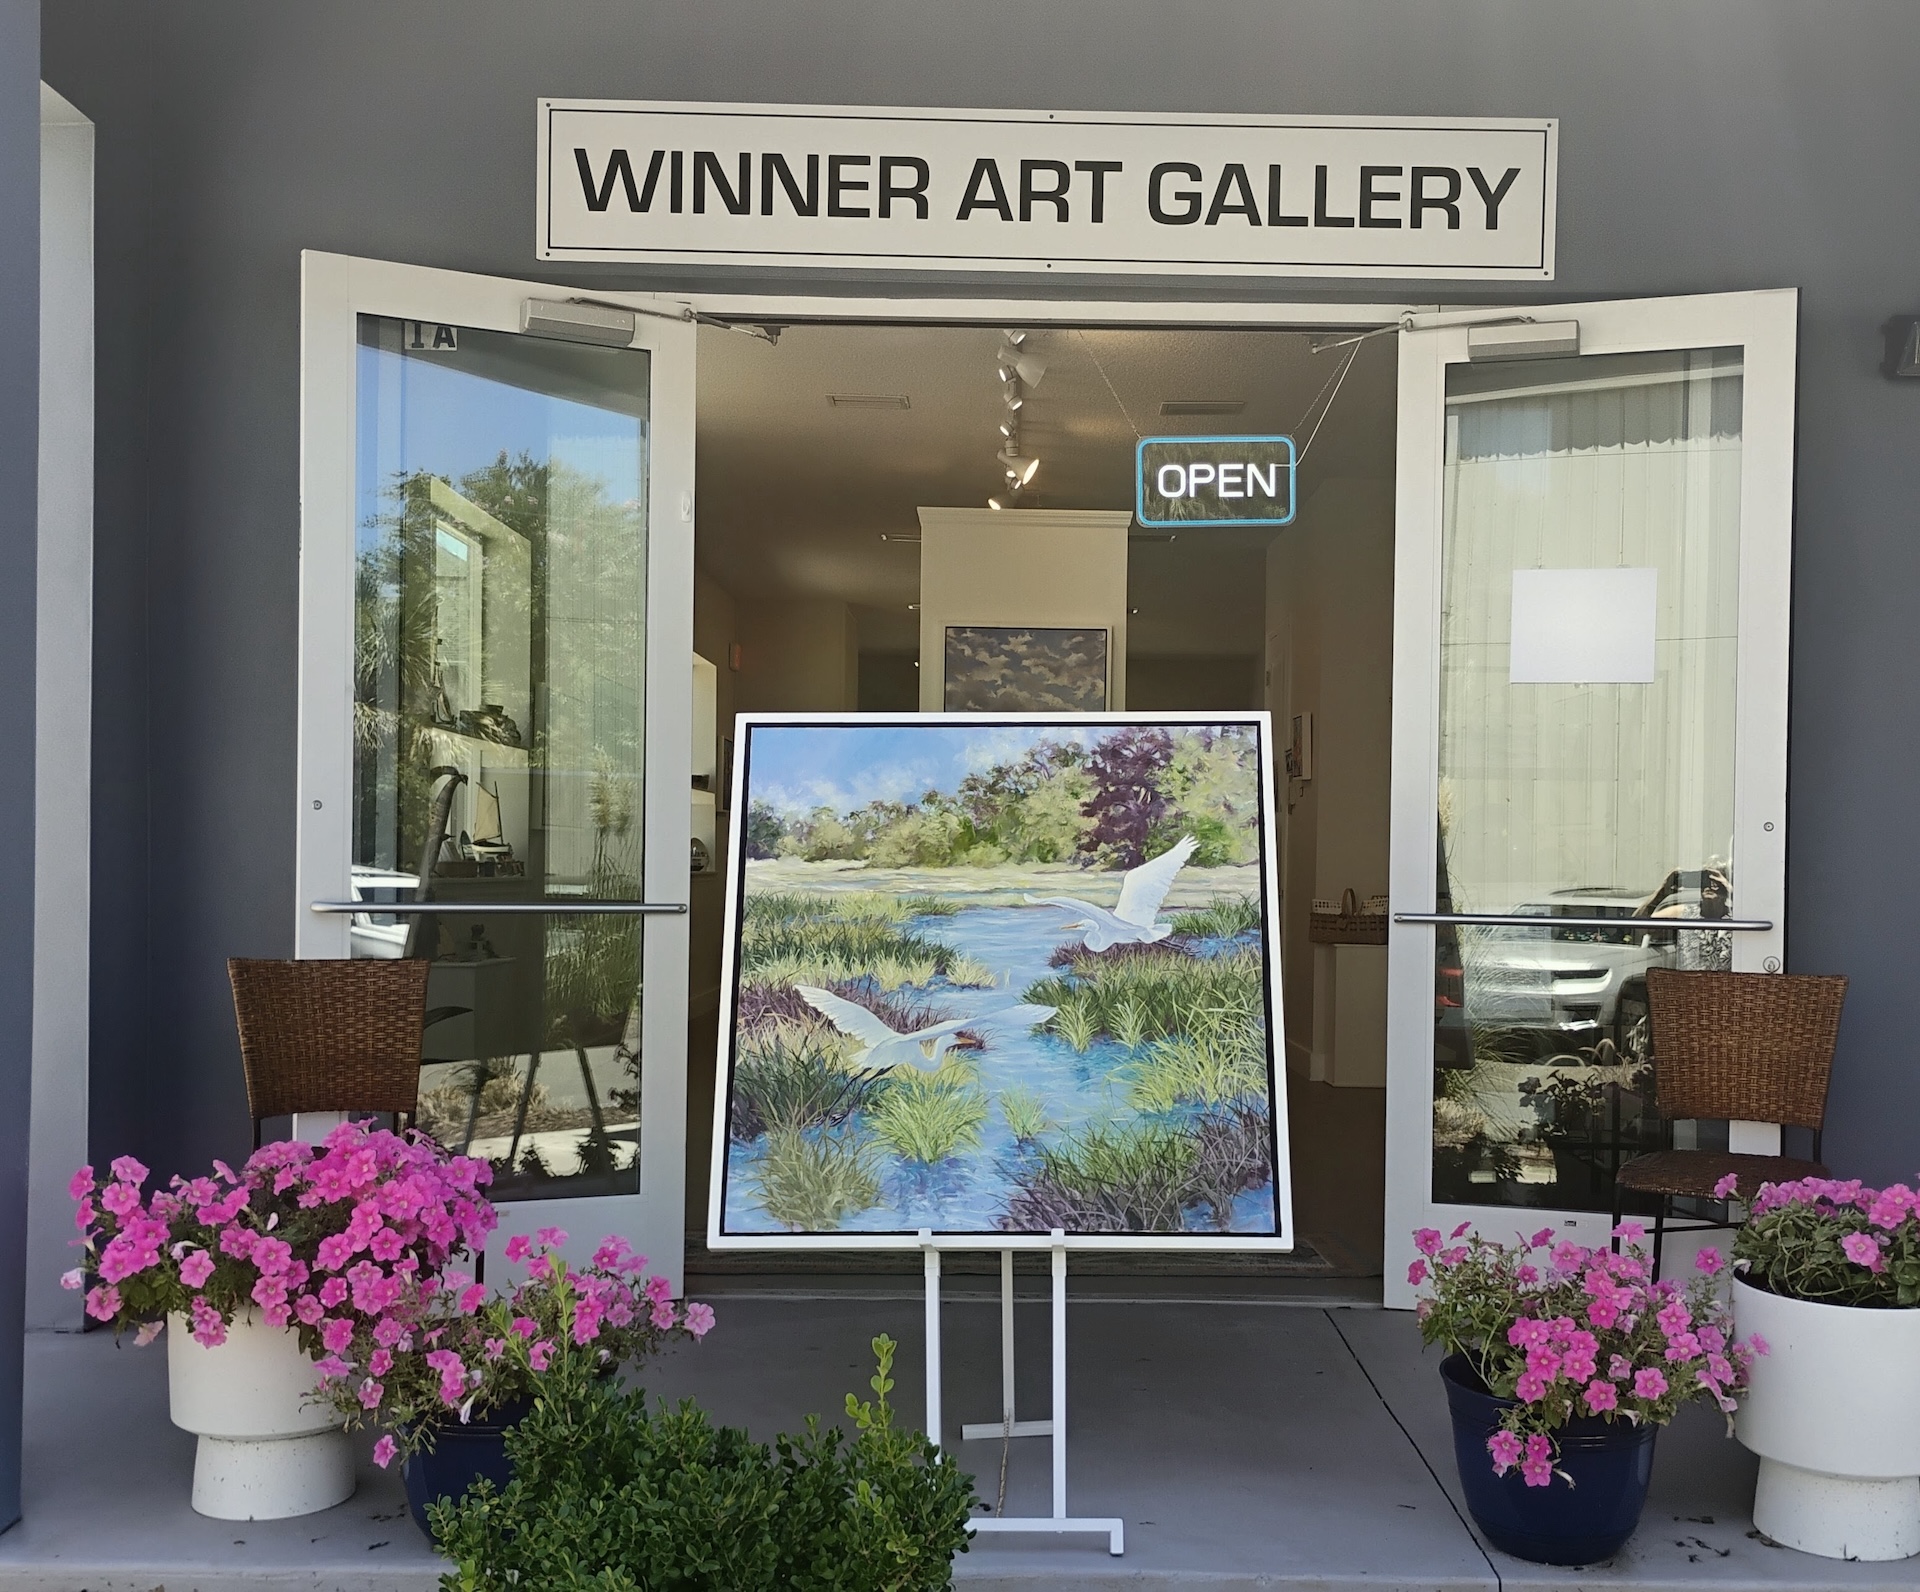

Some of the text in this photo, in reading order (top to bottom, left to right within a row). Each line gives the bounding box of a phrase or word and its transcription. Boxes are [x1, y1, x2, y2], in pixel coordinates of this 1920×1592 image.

[574, 147, 1522, 231] WINNER ART GALLERY
[1157, 463, 1277, 498] OPEN
